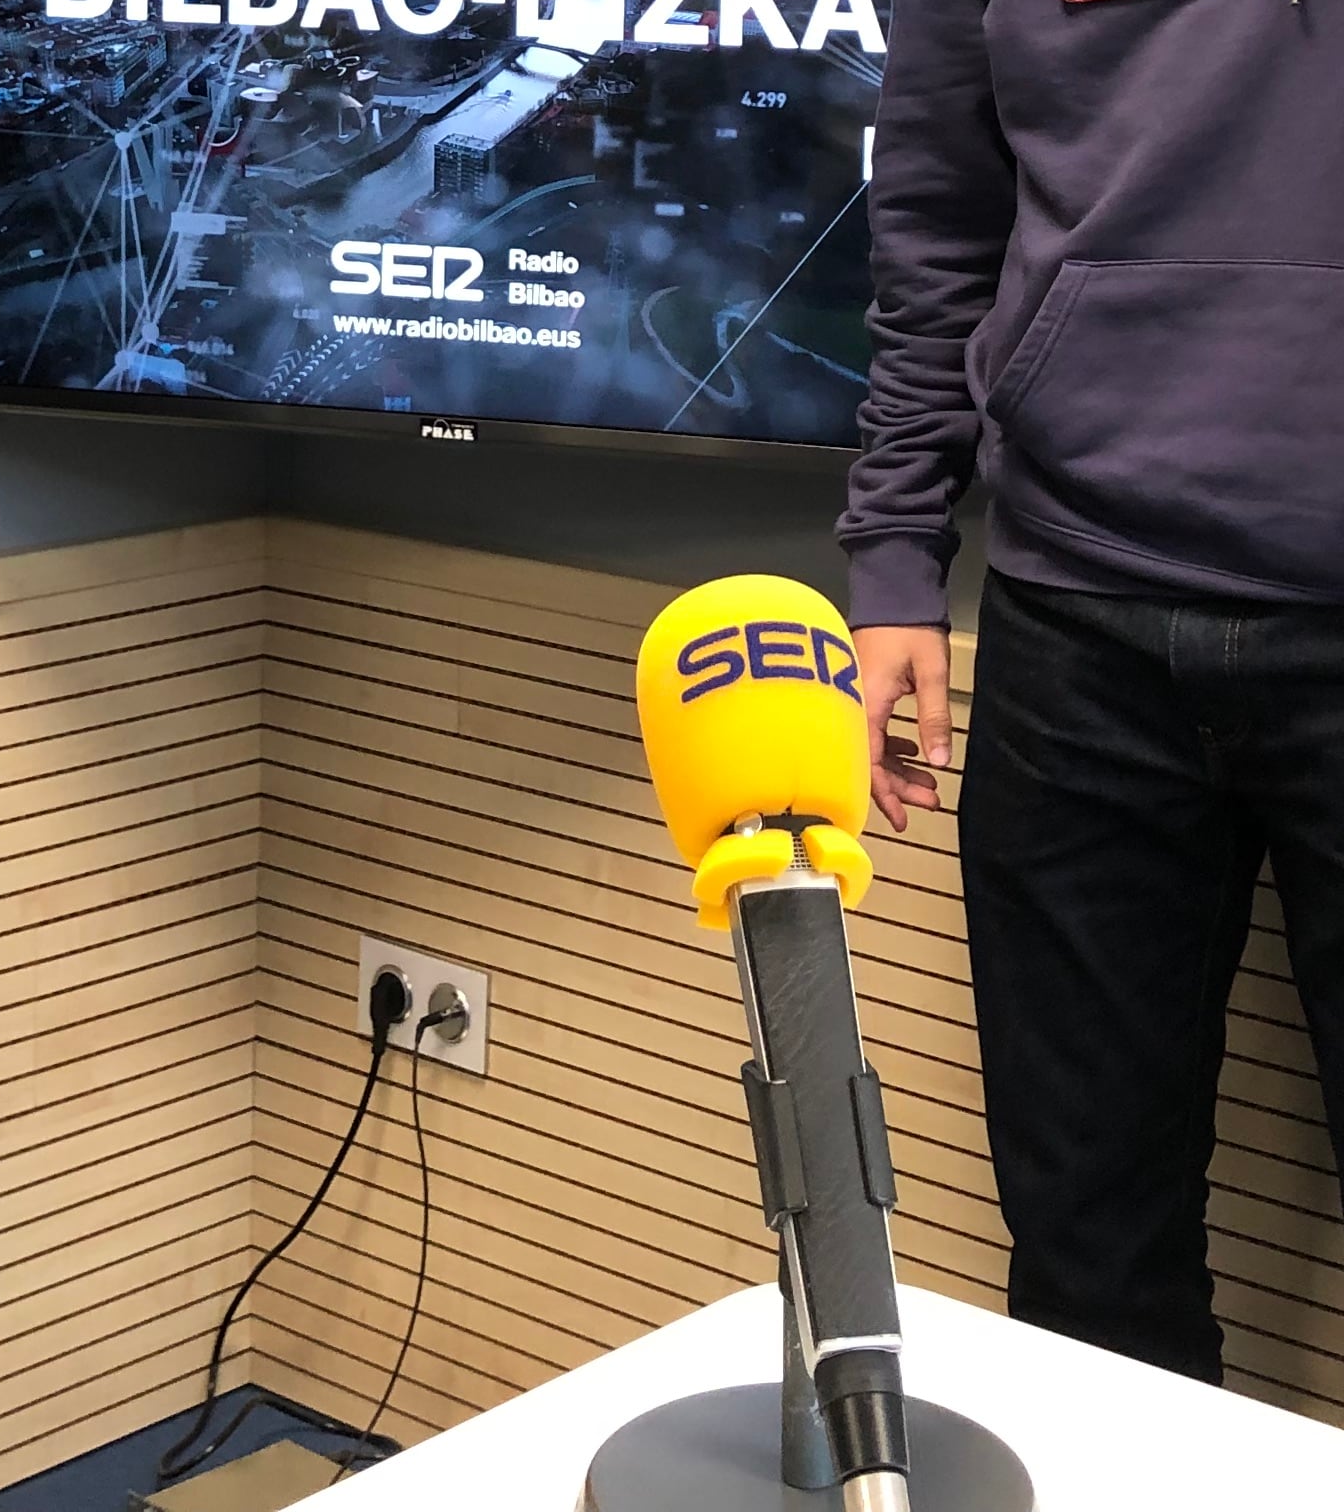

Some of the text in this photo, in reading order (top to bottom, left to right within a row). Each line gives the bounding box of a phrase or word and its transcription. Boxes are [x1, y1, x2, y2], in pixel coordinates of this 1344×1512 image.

[740, 90, 788, 109] 4.299
[330, 240, 484, 302] SER
[508, 248, 579, 274] Radio
[508, 282, 586, 309] Bilbao
[333, 311, 582, 349] www.radiobilbao.eus
[421, 425, 475, 441] PHASE
[677, 621, 863, 705] SER
